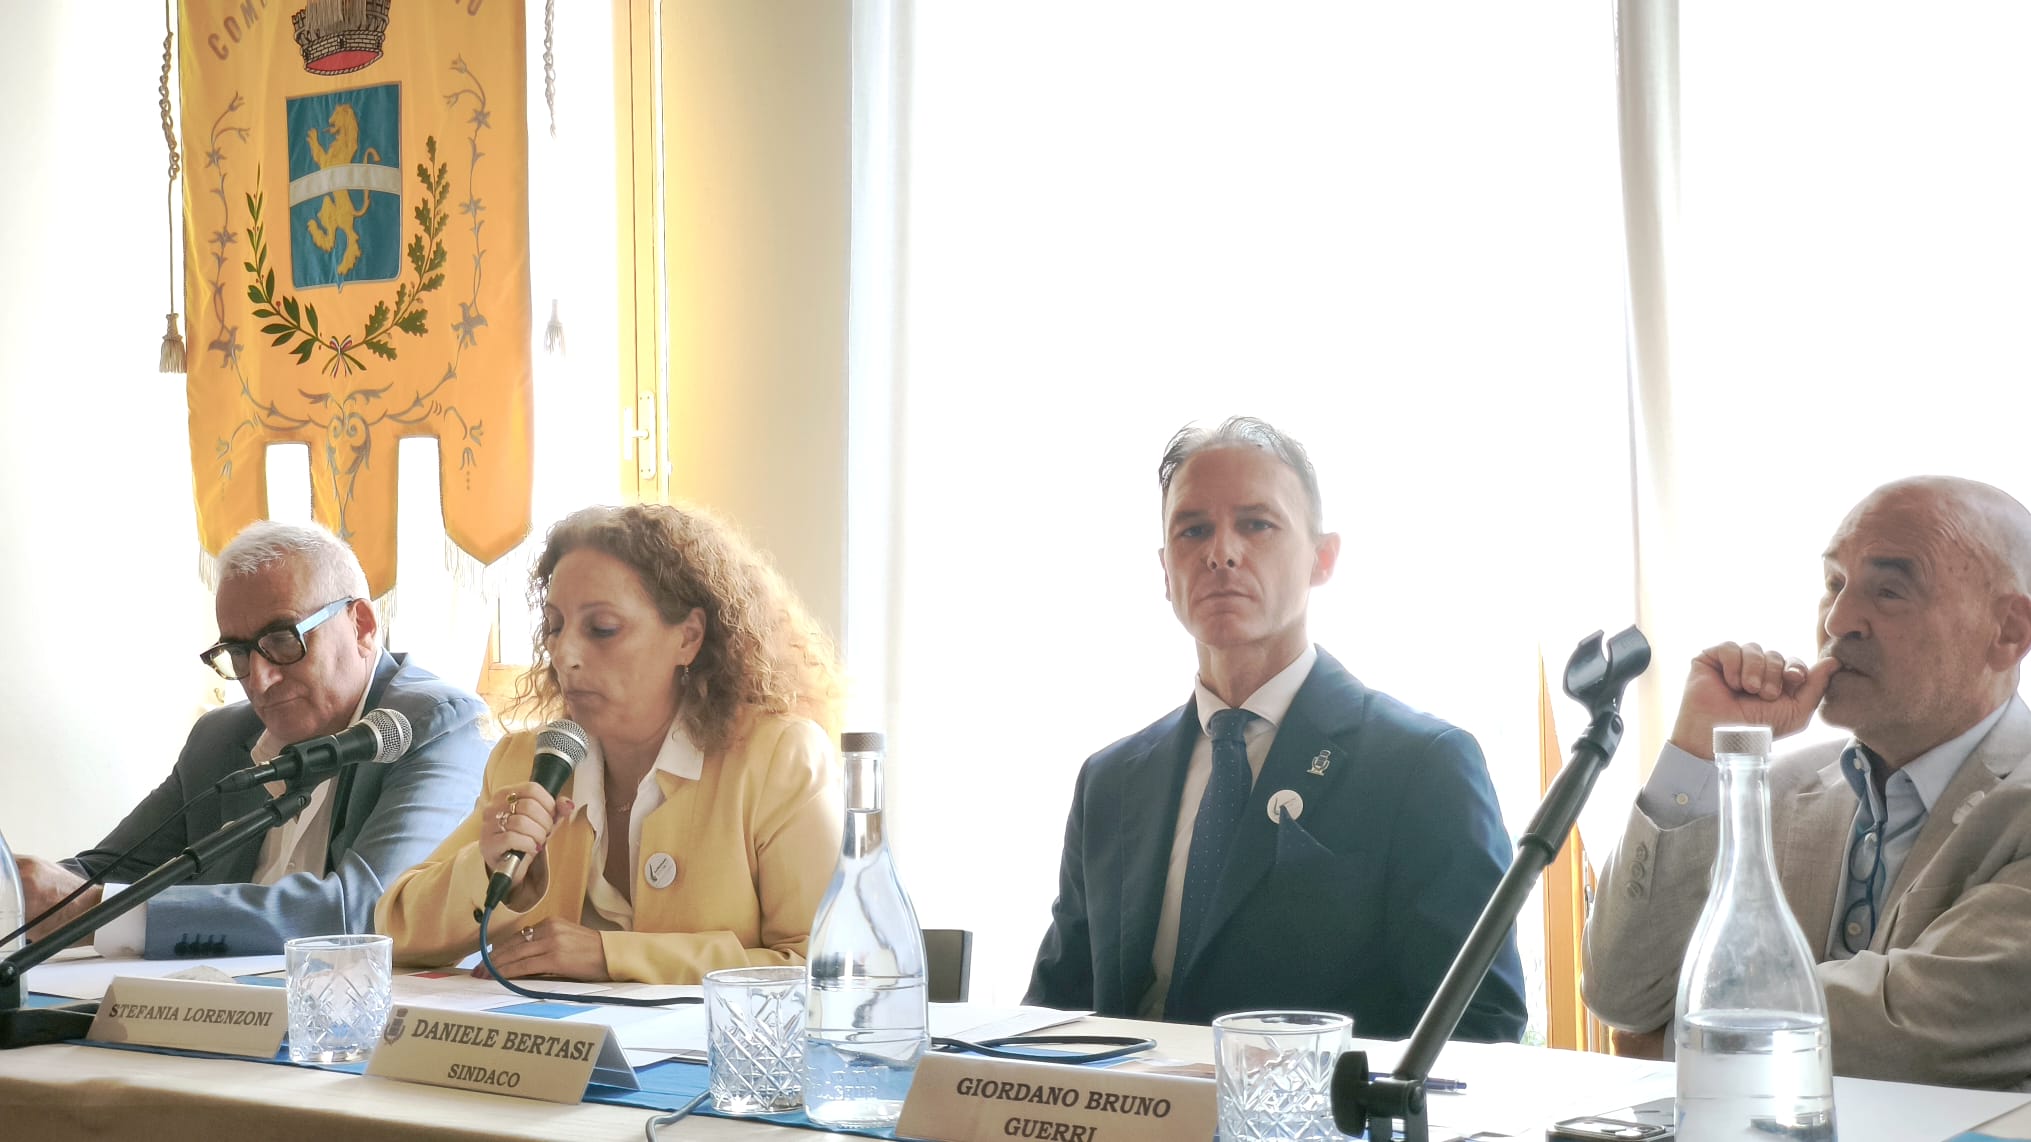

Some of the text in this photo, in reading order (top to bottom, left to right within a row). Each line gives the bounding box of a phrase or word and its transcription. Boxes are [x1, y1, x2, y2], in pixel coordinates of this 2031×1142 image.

[208, 0, 267, 60] COM
[108, 1003, 273, 1027] STEFANIA LORENZONI
[411, 1018, 595, 1062] DANIELE BERTASI
[447, 1063, 521, 1088] SINDACO
[956, 1077, 1172, 1119] GIORDANO BRUNO
[1004, 1117, 1098, 1142] GUERRI
